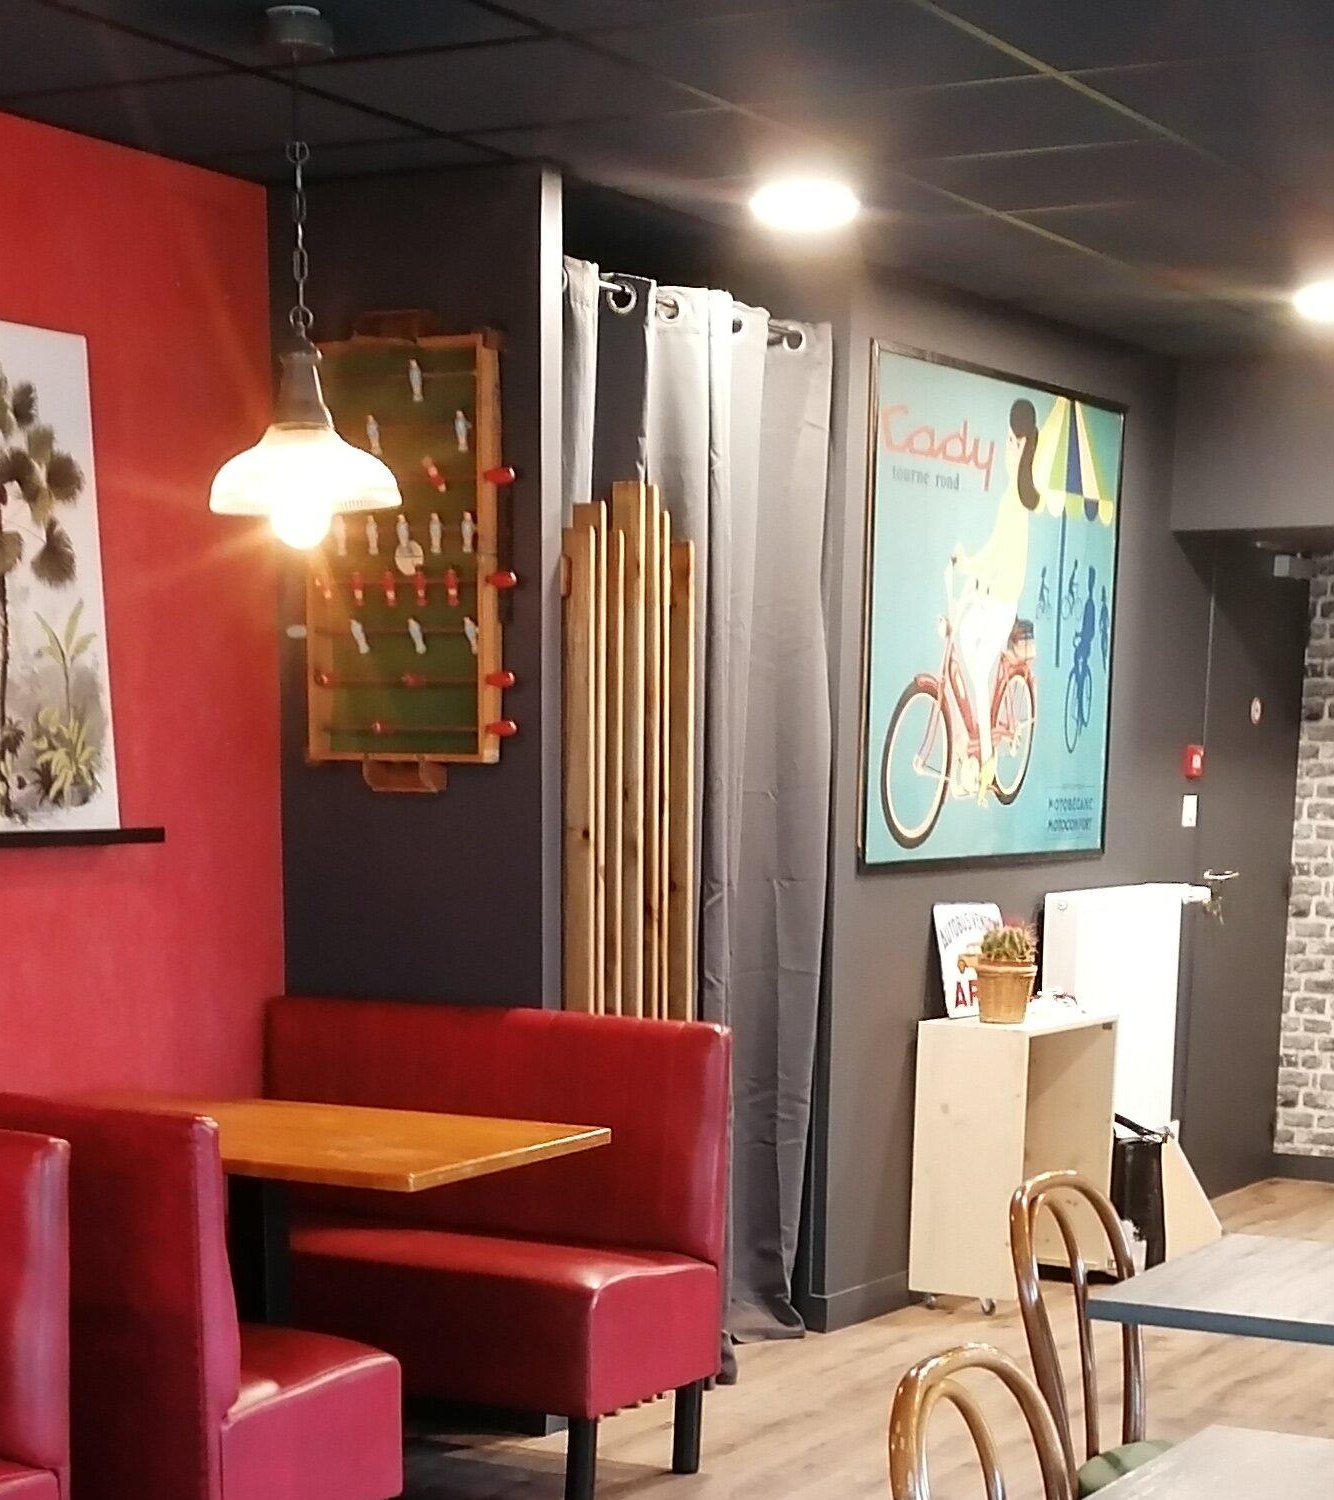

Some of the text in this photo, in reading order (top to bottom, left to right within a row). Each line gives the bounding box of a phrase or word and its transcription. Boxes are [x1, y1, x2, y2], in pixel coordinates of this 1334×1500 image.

[880, 403, 996, 492] Cady
[891, 465, 960, 490] tourne rond
